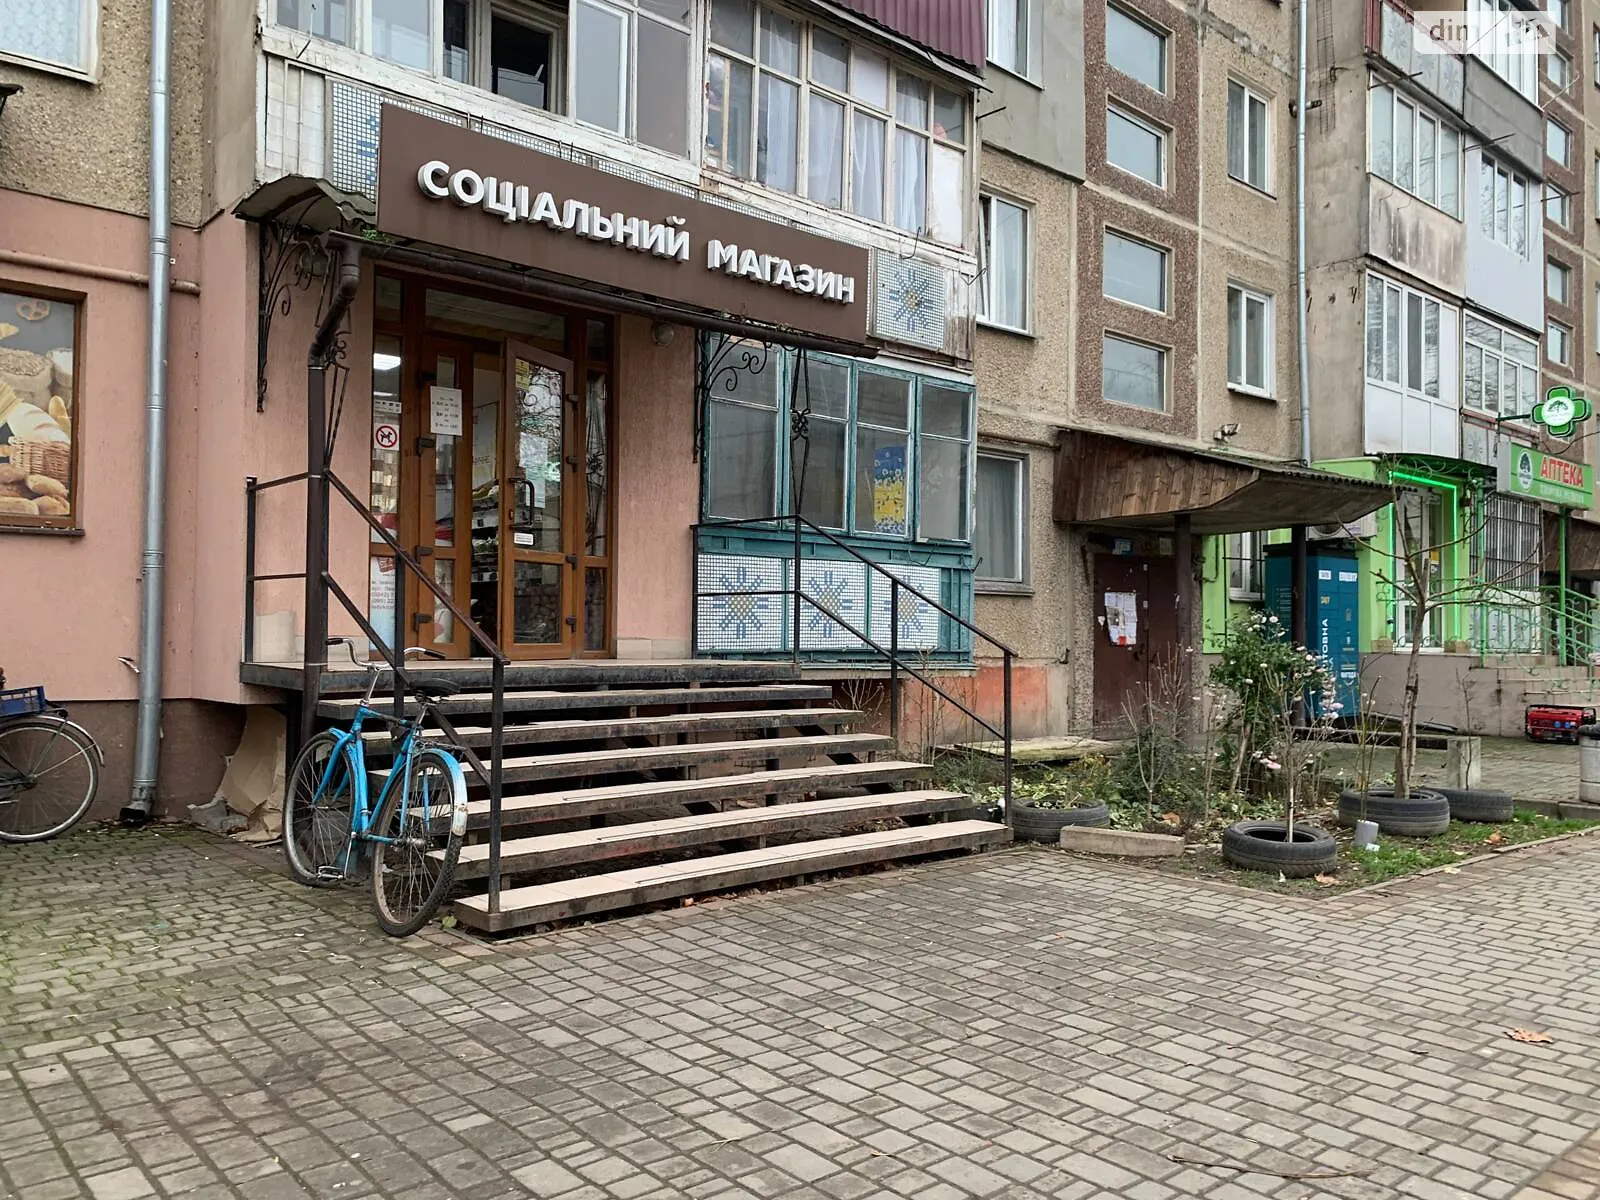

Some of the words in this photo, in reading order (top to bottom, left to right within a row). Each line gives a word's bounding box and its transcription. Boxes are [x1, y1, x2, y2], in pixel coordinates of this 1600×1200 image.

[417, 160, 690, 262] СОЦІАЛЬНИЙ
[707, 239, 855, 304] МАГАЗИН
[1540, 455, 1584, 488] АПТЕКА
